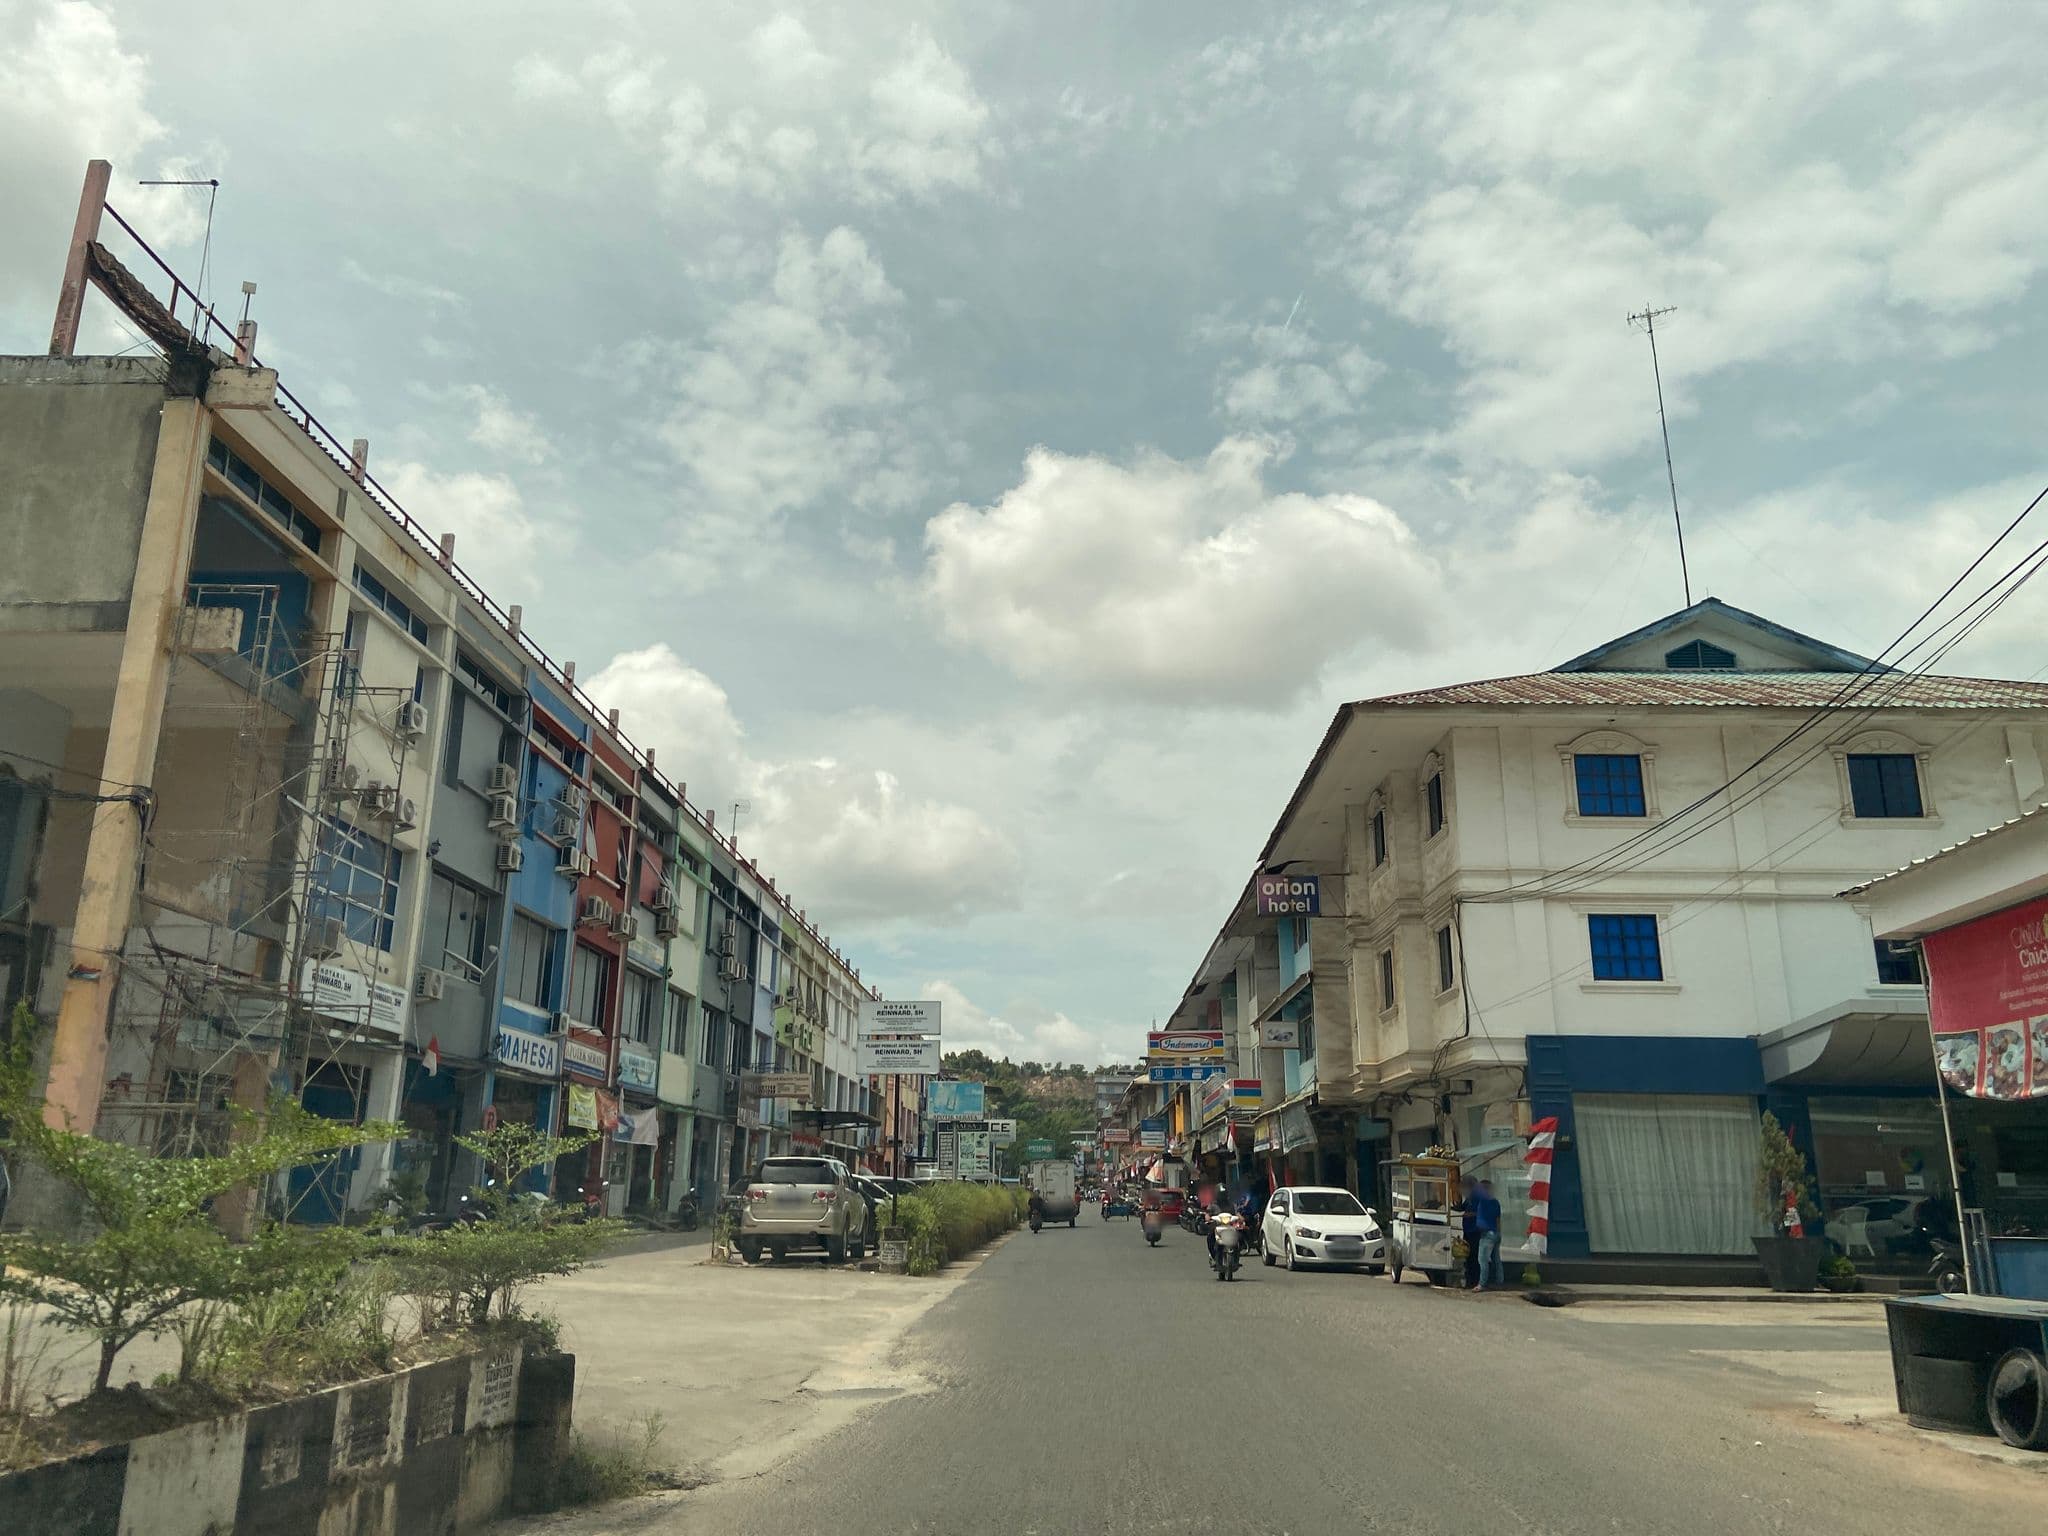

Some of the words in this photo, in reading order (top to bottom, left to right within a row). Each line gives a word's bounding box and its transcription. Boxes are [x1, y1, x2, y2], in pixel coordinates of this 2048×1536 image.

[1262, 878, 1316, 896] orion
[1268, 897, 1311, 913] hotel
[501, 1033, 553, 1071] MAHESA
[1163, 1039, 1210, 1049] Indomaret
